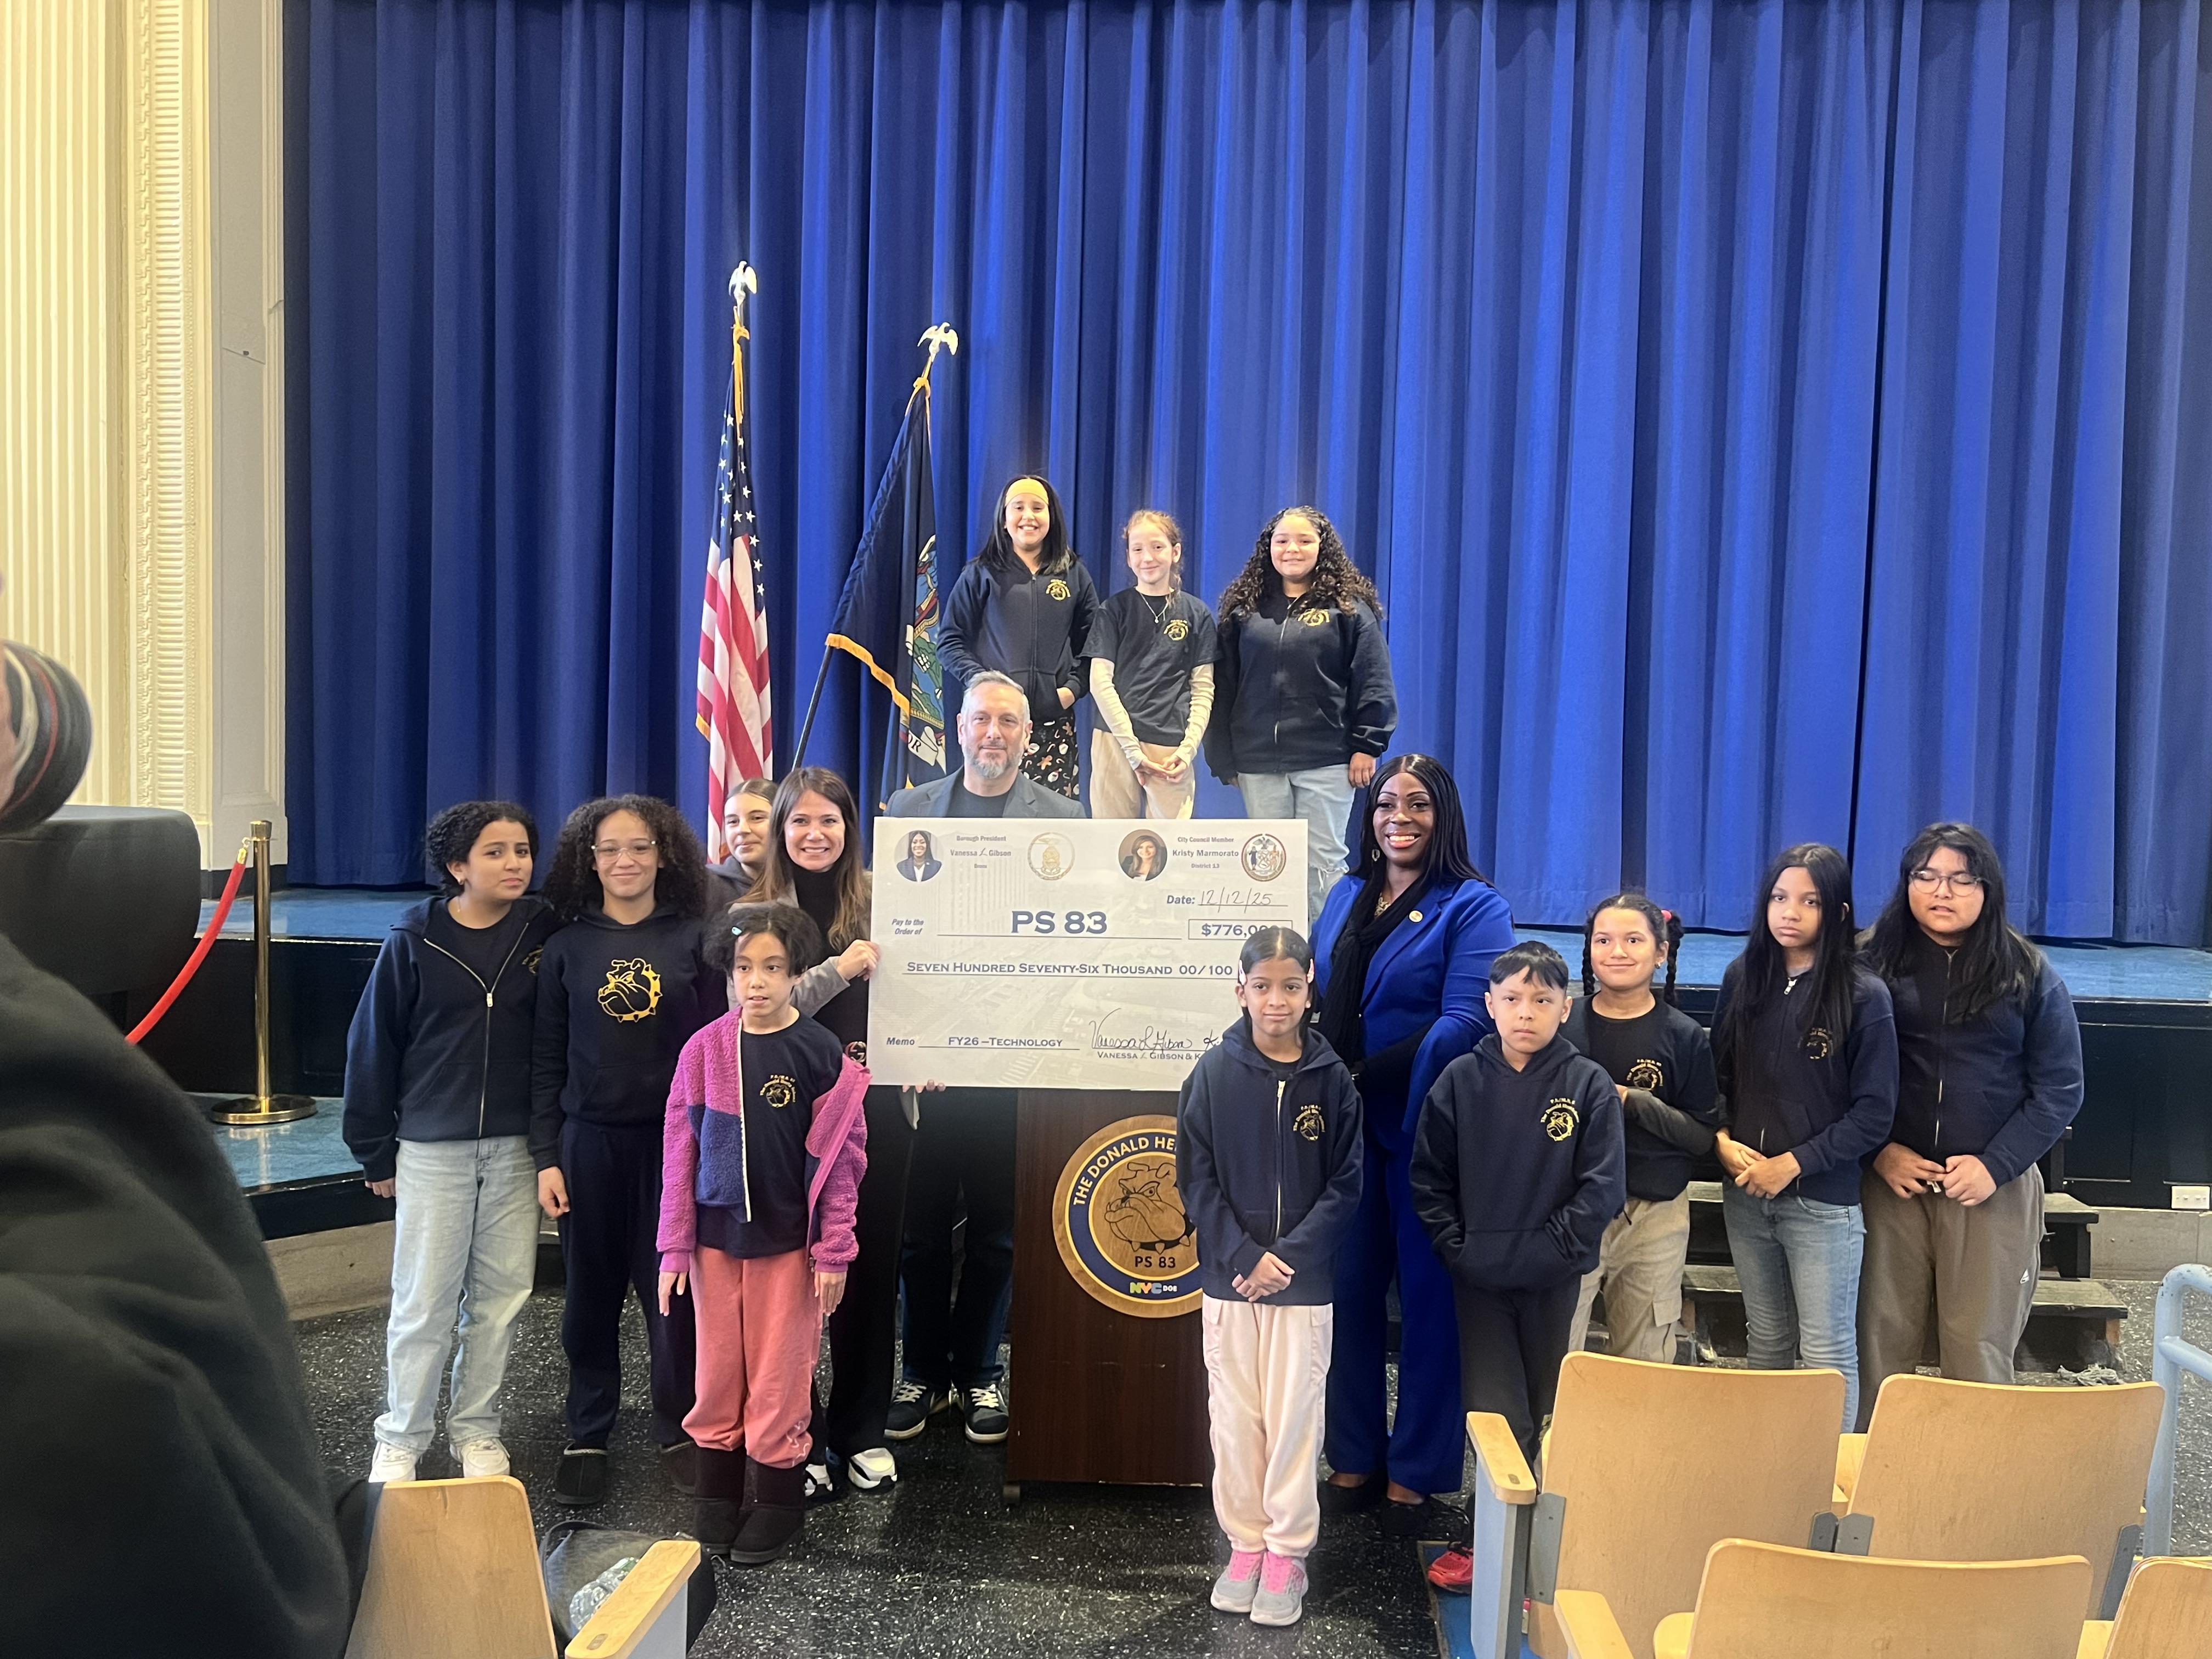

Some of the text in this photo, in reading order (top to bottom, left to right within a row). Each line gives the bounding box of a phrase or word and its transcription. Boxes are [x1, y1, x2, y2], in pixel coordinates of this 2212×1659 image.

[1172, 849, 1194, 857] Kristy
[1167, 895, 1195, 905] Date:
[1200, 887, 1273, 913] 12/12/25
[891, 918, 904, 927] Pay
[1011, 911, 1107, 934] PS 83
[886, 1037, 915, 1046] Memo
[948, 1037, 979, 1046] FY26
[1073, 1136, 1177, 1206] THE DONALD HE
[1135, 1256, 1176, 1268] PS 83
[1130, 1282, 1162, 1294] NYC
